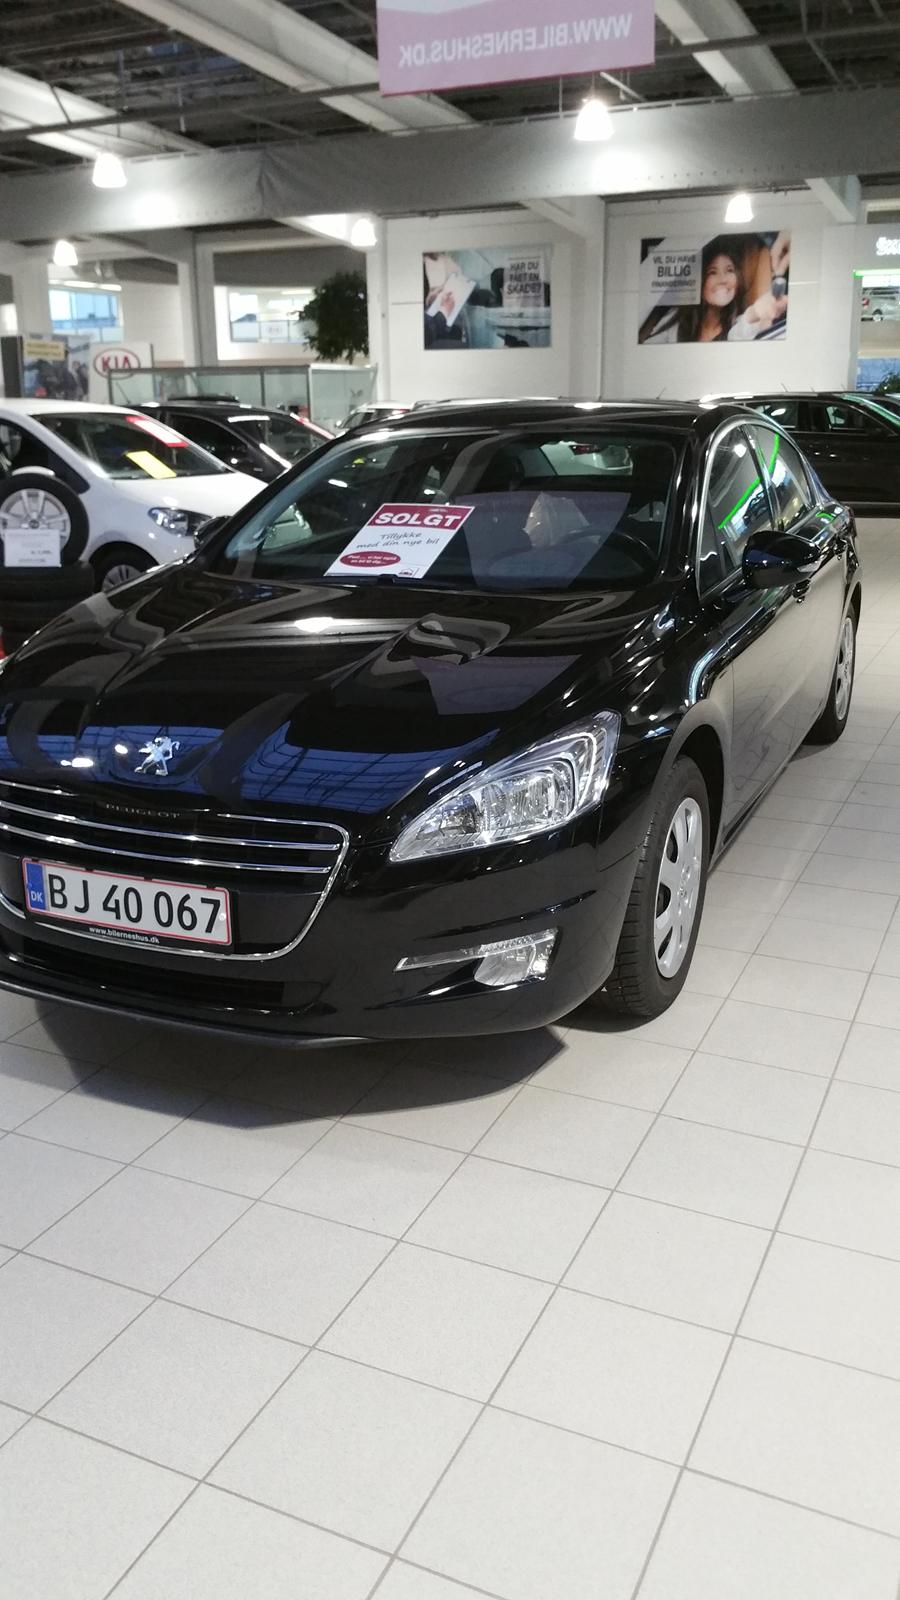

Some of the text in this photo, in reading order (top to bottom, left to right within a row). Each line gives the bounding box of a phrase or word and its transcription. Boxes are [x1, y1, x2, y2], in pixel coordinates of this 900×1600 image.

[665, 256, 676, 264] DU
[677, 254, 696, 263] HAVE
[510, 261, 540, 271] HAR DU
[657, 265, 691, 278] BILLIG
[529, 272, 540, 281] EN
[101, 356, 132, 372] KIA
[374, 512, 461, 527] SOLGT
[380, 532, 423, 540] Tillykke
[106, 803, 181, 818] PEUGEOT
[30, 890, 44, 903] DK
[47, 874, 222, 934] BJ 40 067
[88, 926, 160, 944] www.bilerneshus.dk
